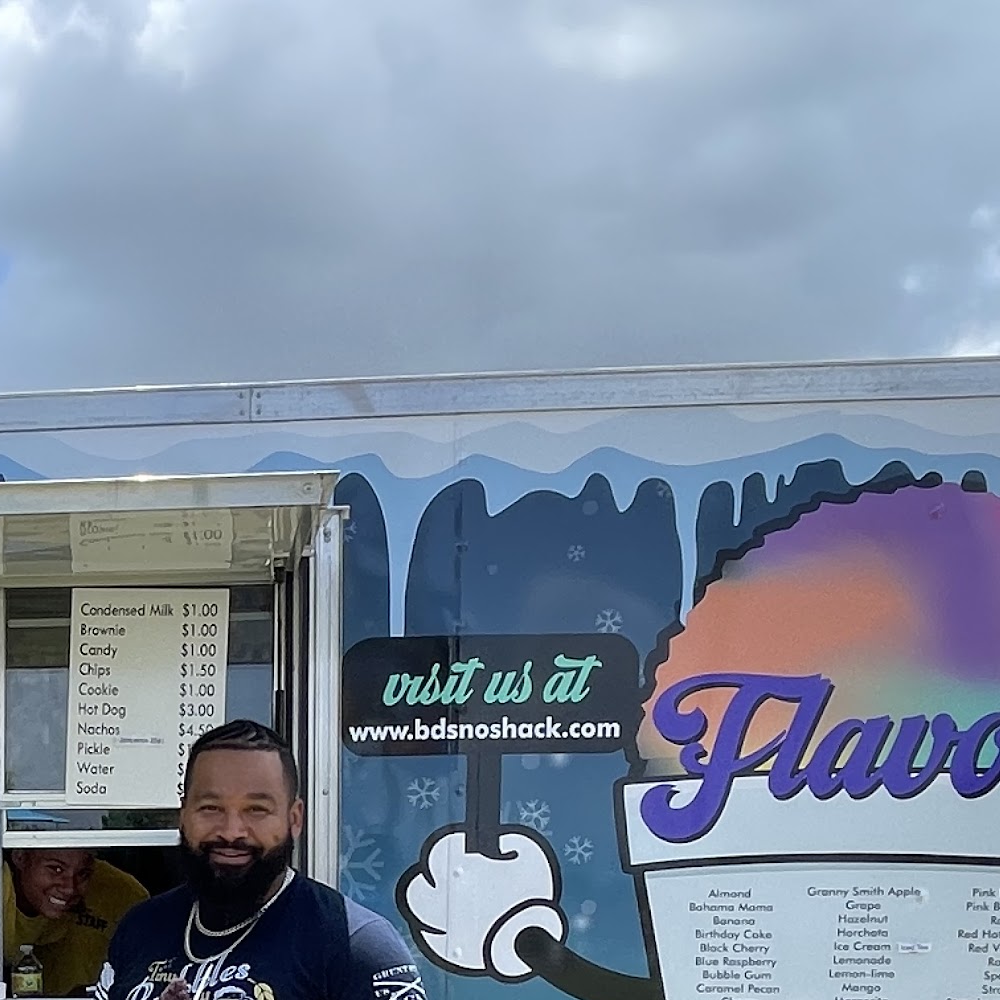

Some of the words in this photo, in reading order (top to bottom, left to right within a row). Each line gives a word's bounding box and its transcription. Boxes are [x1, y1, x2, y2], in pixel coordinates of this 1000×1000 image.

[80, 603, 145, 617] Condensed
[150, 603, 174, 617] Milk
[182, 603, 218, 618] $1.00
[80, 624, 126, 637] Brownie
[181, 623, 217, 638] $1.00
[79, 643, 118, 658] Candy
[181, 643, 217, 658] $1.00
[79, 663, 111, 677] Chips
[180, 662, 216, 677] $1.50
[382, 657, 485, 707] visit
[482, 660, 534, 704] us
[542, 654, 603, 704] at
[78, 683, 119, 696] Cookie
[179, 683, 215, 697] $1.00
[78, 703, 99, 716] Hot
[102, 703, 127, 719] Dog
[178, 702, 215, 717] $3.00
[78, 722, 120, 735] Nachos
[348, 716, 621, 742] www.bdsnoshack.com
[77, 742, 111, 755] Pickle
[77, 763, 114, 775] Water
[77, 783, 107, 795] Soda
[708, 888, 752, 898] Almond
[807, 886, 849, 898] Granny
[852, 886, 884, 896] Smith
[888, 887, 921, 898] Apple
[713, 915, 755, 925] Banana
[838, 914, 889, 923] Hazelnut
[695, 929, 740, 941] Birthday
[700, 942, 729, 953] Black
[732, 943, 770, 955] Cherry
[834, 941, 849, 951] Ice
[853, 941, 891, 951] Cream
[695, 956, 719, 966] Blue
[723, 956, 777, 968] Raspberry
[833, 955, 892, 965] Lemonade
[702, 970, 740, 980] Bubble
[744, 970, 772, 980] Gum
[696, 983, 744, 993] Caramel
[841, 983, 881, 994] Mango
